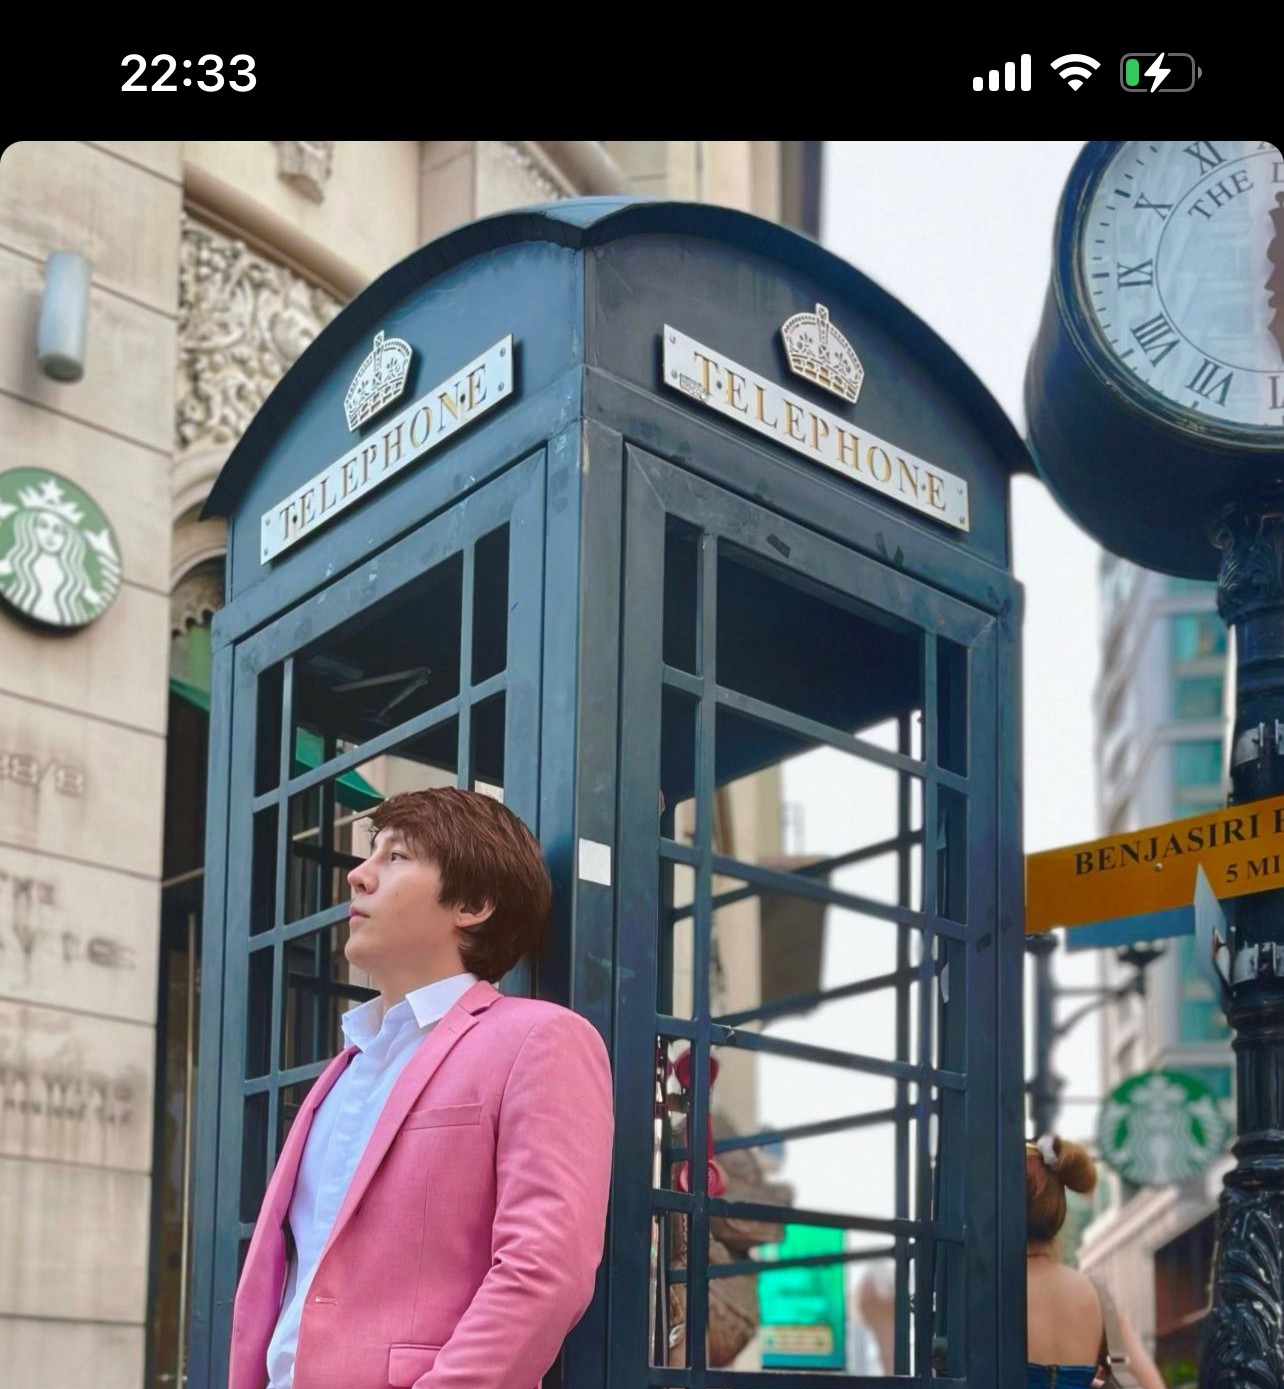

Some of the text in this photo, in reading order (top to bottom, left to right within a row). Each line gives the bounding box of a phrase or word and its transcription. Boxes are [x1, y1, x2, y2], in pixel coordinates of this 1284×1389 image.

[1133, 191, 1174, 221] X
[1187, 169, 1254, 220] THE
[1117, 259, 1154, 290] IX
[1130, 312, 1181, 367] VIII
[1185, 358, 1234, 407] VII
[279, 364, 488, 541] TELEPHONE
[694, 352, 947, 512] TELEPHONE
[1075, 814, 1258, 876] BENJASIRI
[1226, 863, 1238, 884] 5
